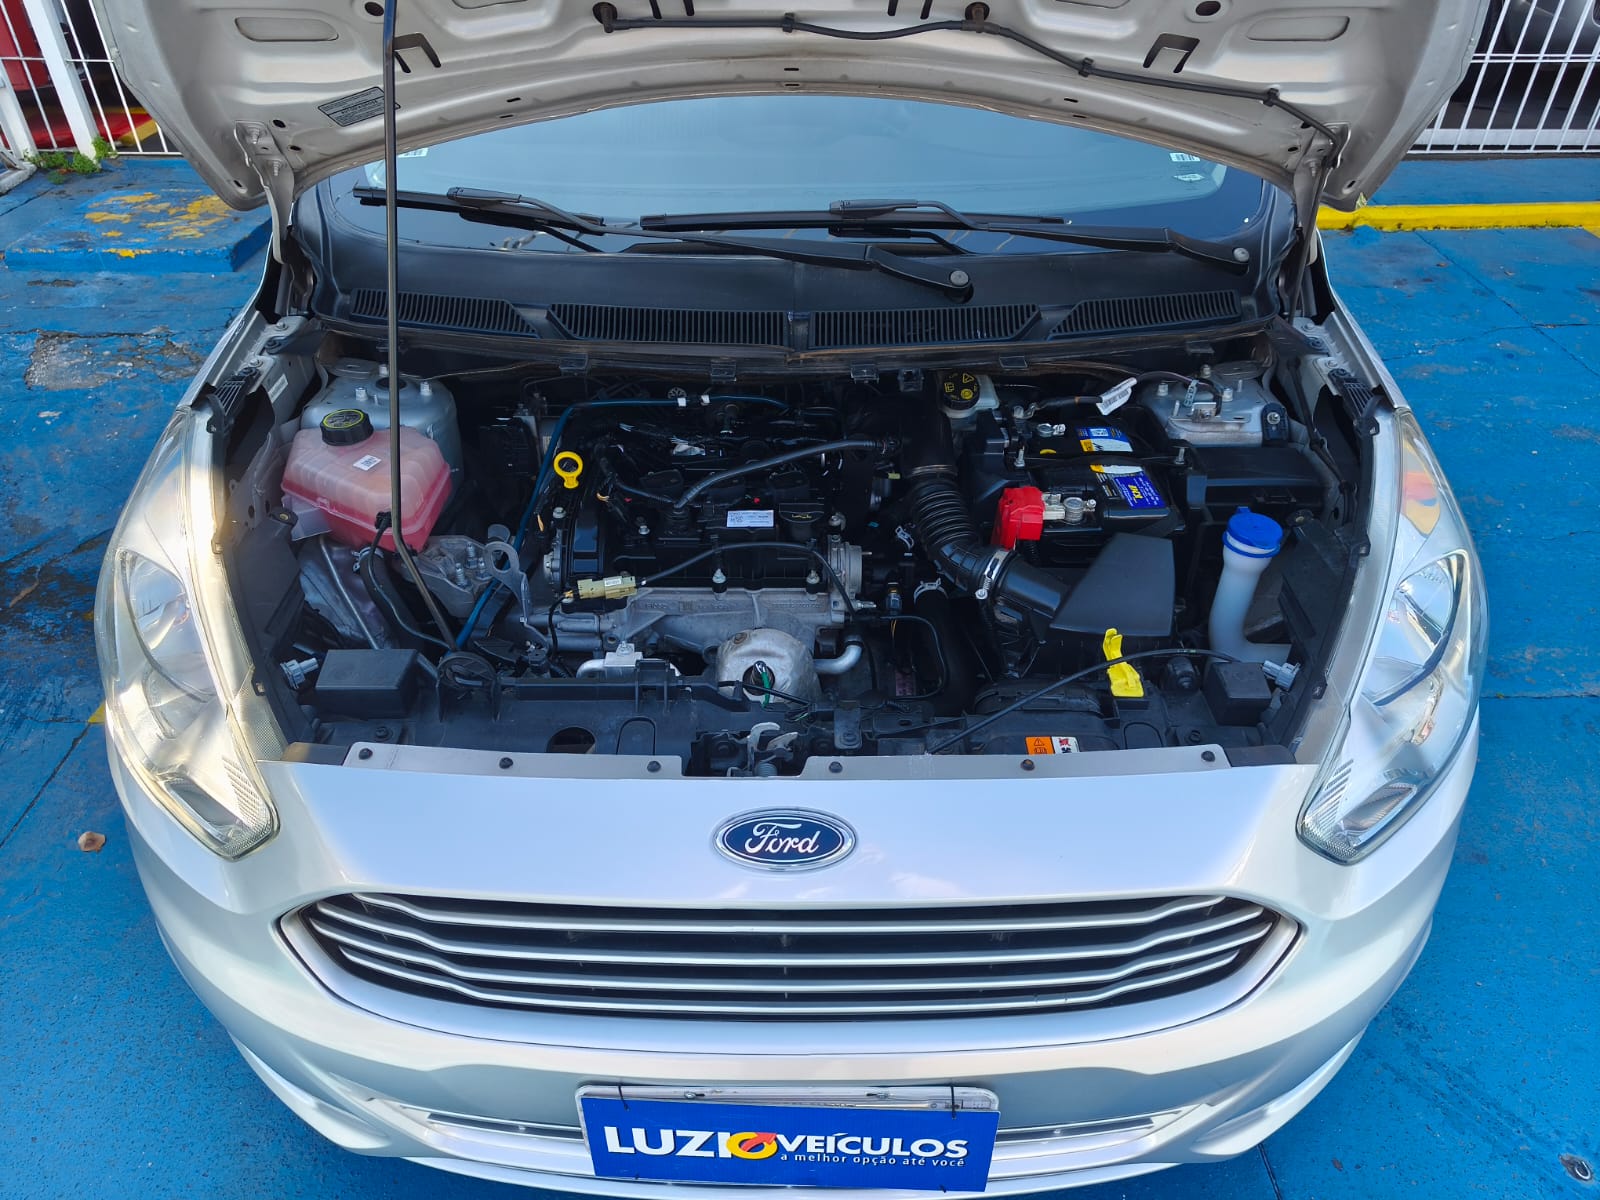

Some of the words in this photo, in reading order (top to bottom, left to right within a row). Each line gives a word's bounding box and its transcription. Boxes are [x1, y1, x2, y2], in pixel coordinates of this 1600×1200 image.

[744, 822, 821, 854] Ford
[776, 1132, 969, 1158] VEÍCULOS
[780, 1153, 788, 1161] a
[795, 1152, 847, 1163] melhor
[853, 1155, 896, 1166] opção
[902, 1156, 926, 1166] até
[932, 1157, 965, 1167] você
